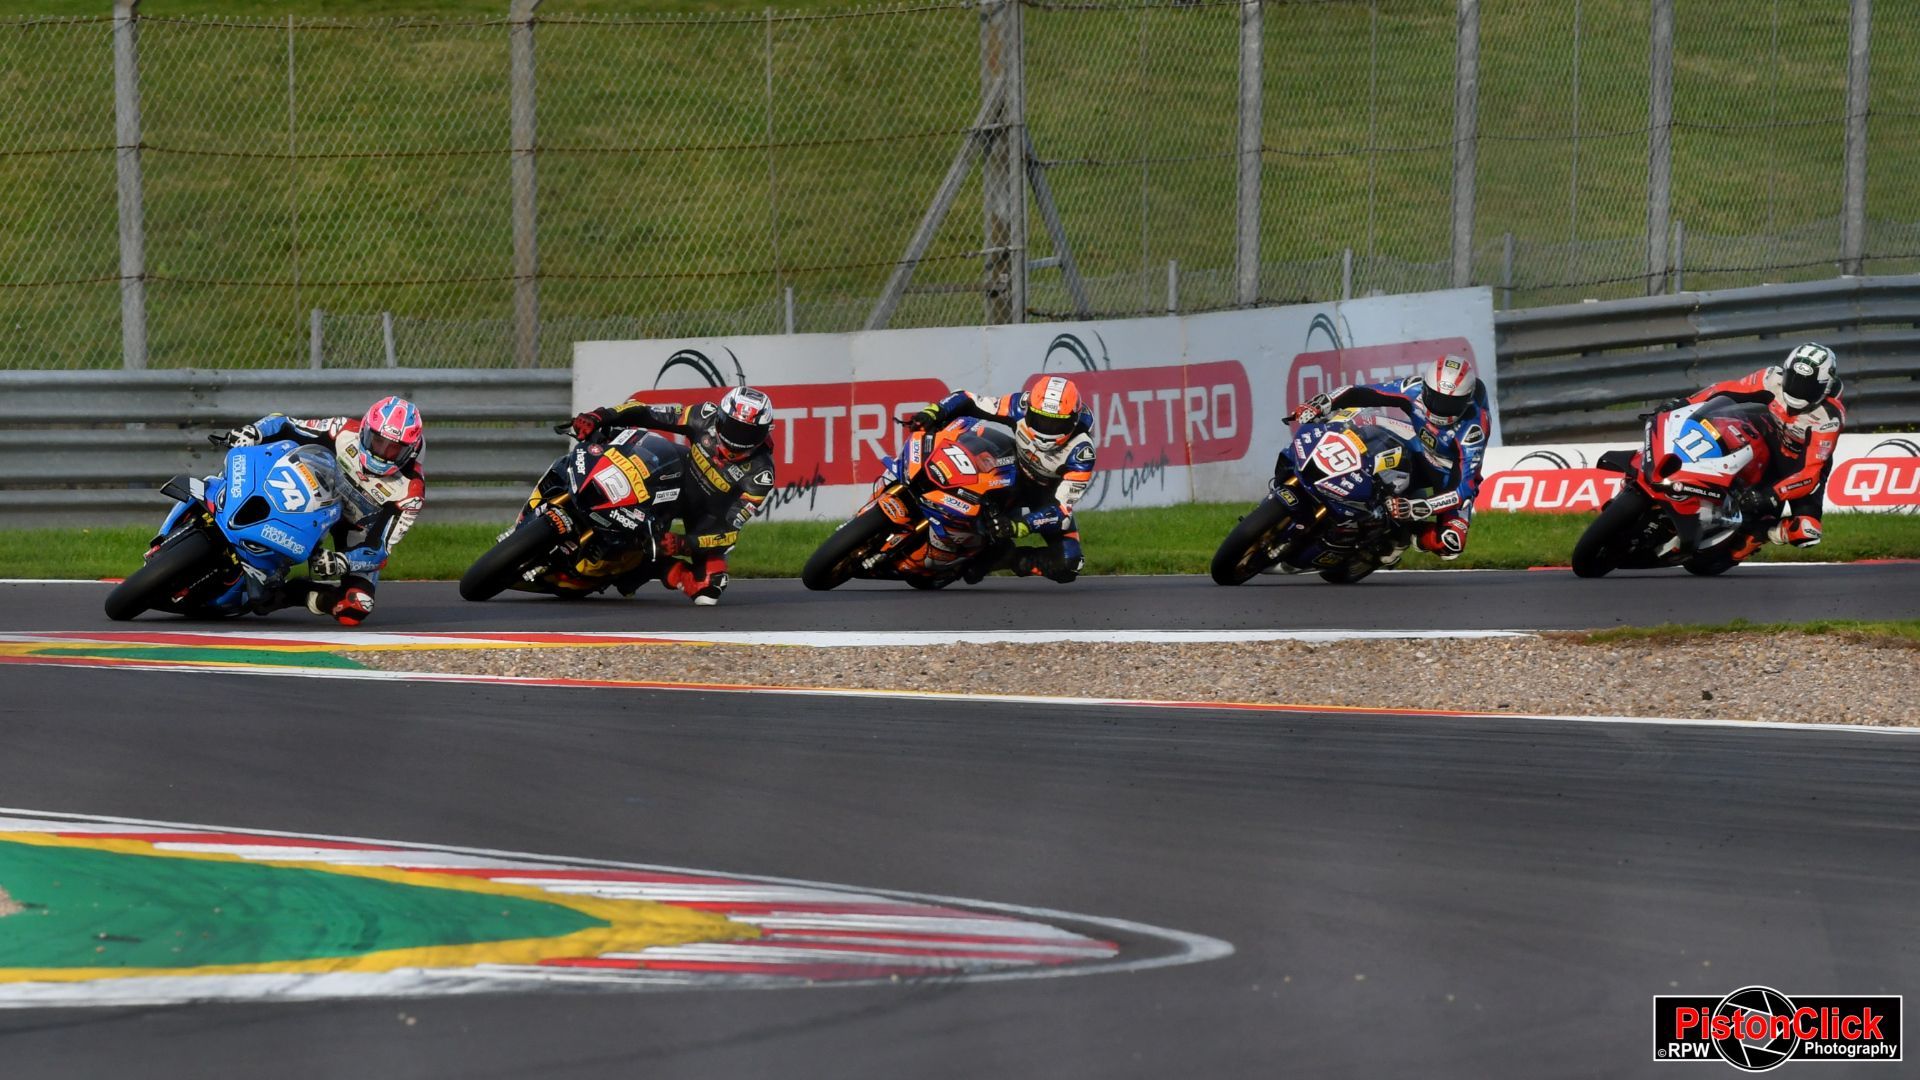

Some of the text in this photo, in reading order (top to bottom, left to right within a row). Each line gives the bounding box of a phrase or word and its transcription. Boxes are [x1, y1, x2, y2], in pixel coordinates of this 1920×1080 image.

[942, 445, 977, 474] 19
[1317, 441, 1357, 472] 45
[1673, 429, 1714, 463] 11
[231, 455, 245, 498] mouldings
[266, 470, 306, 511] 74
[609, 449, 648, 501] MILENCO
[1683, 486, 1707, 496] NICHOLL
[1844, 463, 1920, 501] QU
[1491, 476, 1624, 513] QUAT
[261, 529, 305, 555] mouldings
